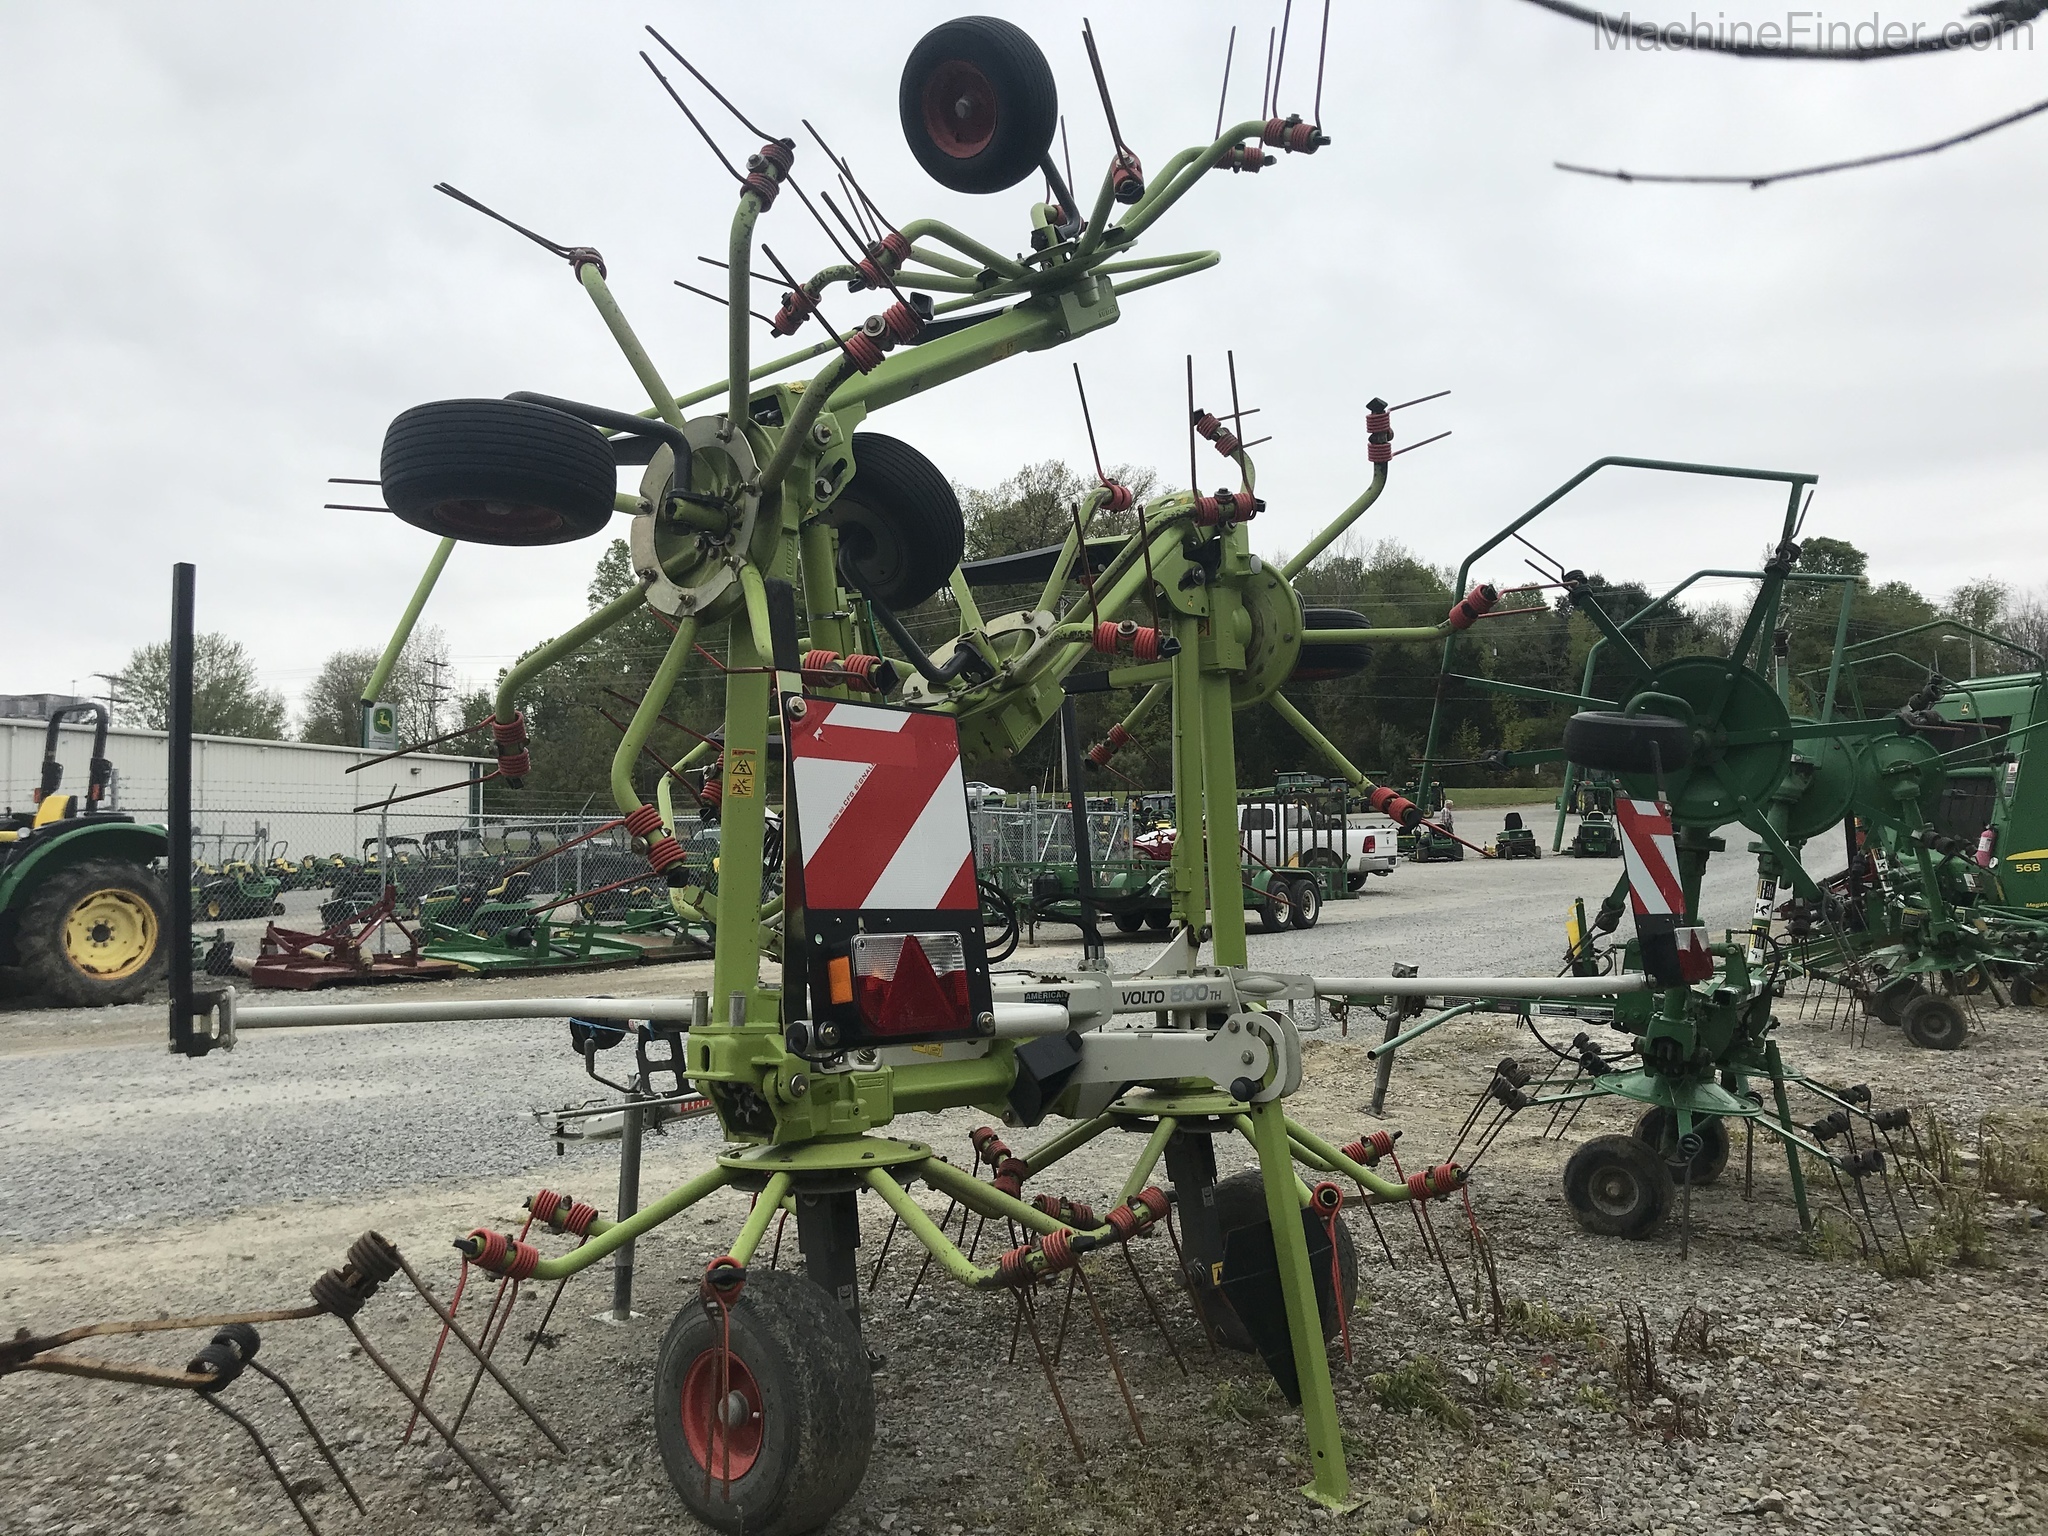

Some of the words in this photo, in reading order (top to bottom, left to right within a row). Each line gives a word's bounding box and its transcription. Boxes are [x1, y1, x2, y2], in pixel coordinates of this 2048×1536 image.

[843, 791, 854, 806] CFG
[2016, 863, 2041, 873] 568
[1122, 990, 1165, 1005] VOLTO
[1169, 984, 1209, 1003] 800
[1210, 990, 1222, 1001] TH
